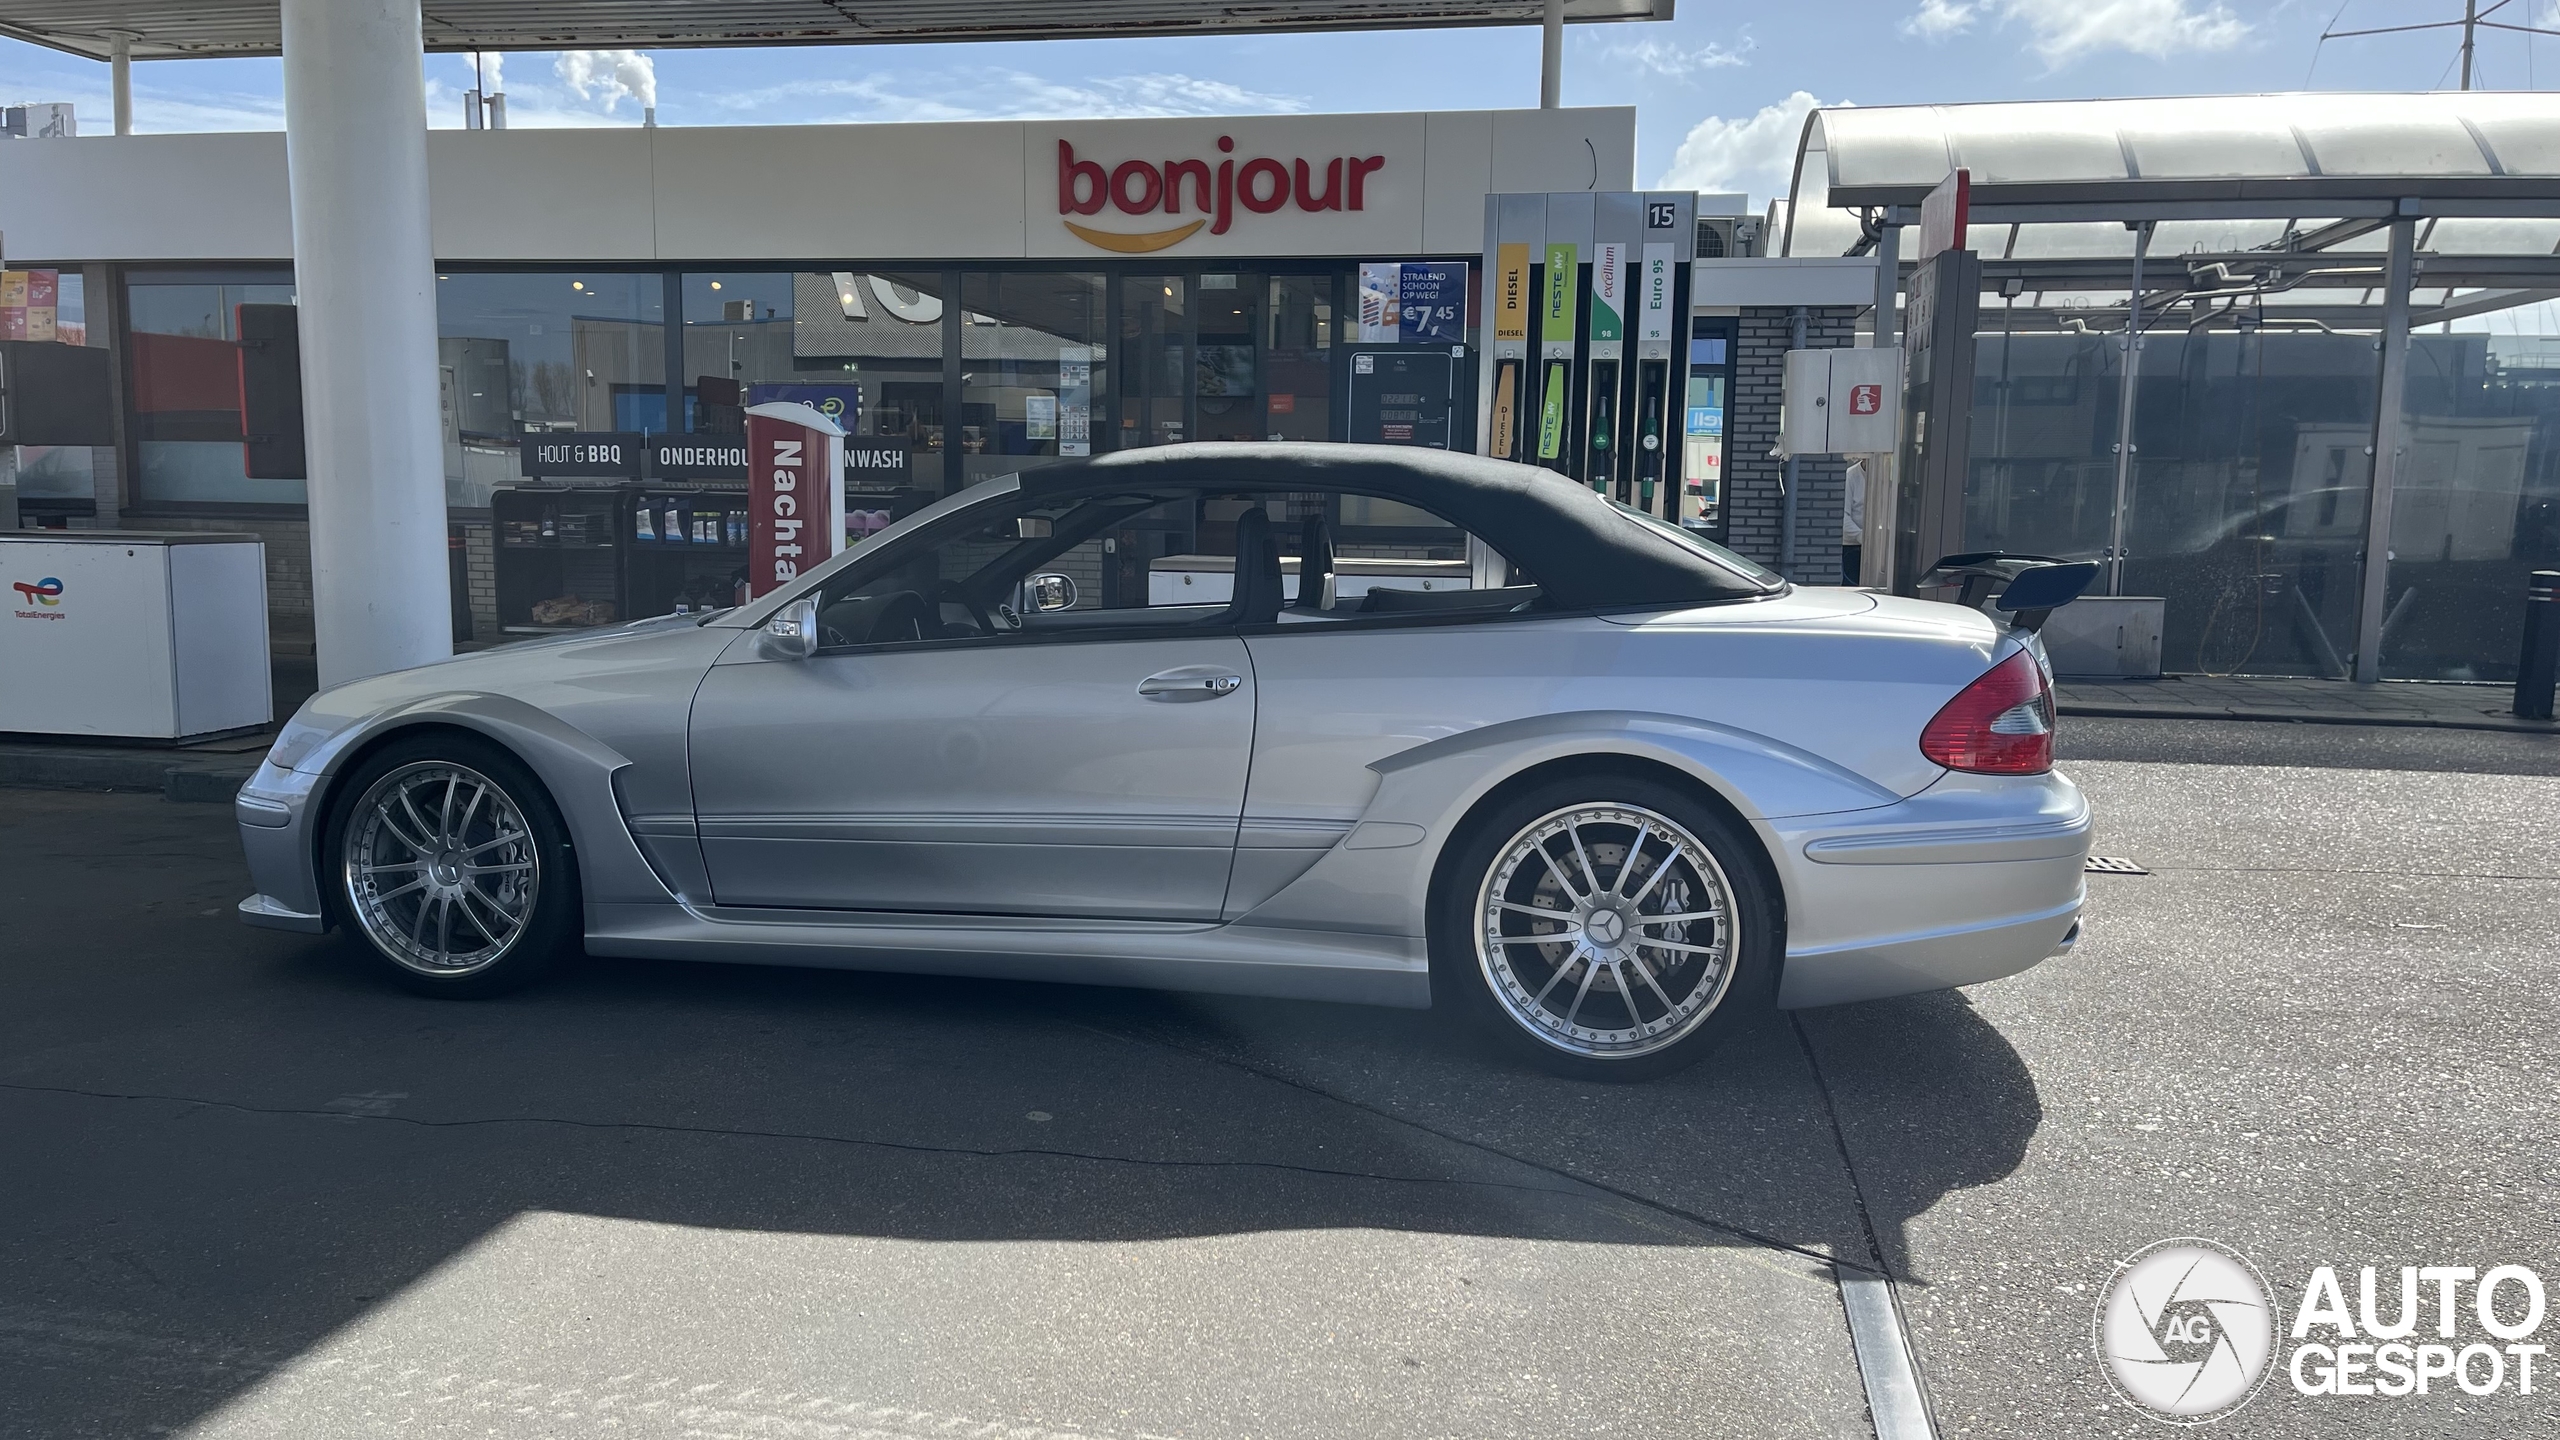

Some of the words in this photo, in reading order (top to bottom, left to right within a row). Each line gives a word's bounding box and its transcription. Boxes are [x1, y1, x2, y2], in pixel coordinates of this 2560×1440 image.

[1058, 135, 1386, 235] bonjour
[1650, 205, 1674, 226] 15
[1554, 251, 1564, 269] MY
[1653, 259, 1664, 274] 95
[1402, 272, 1446, 281] STRALEND
[1602, 246, 1615, 298] excellium
[1402, 282, 1440, 290] SCHOON
[1402, 291, 1415, 299] OP
[1416, 291, 1439, 299] WEG!
[1507, 268, 1519, 310] DIESEL
[1650, 278, 1663, 310] Euro
[1498, 329, 1524, 337] DIESEL
[1650, 330, 1660, 338] 95
[1547, 401, 1556, 415] MY
[1498, 406, 1508, 455] DIESEL
[538, 445, 571, 463] HOUT
[574, 445, 584, 463] &
[587, 444, 622, 465] BBQ
[773, 440, 803, 582] Nachta
[14, 610, 66, 621] TotalEnergies
